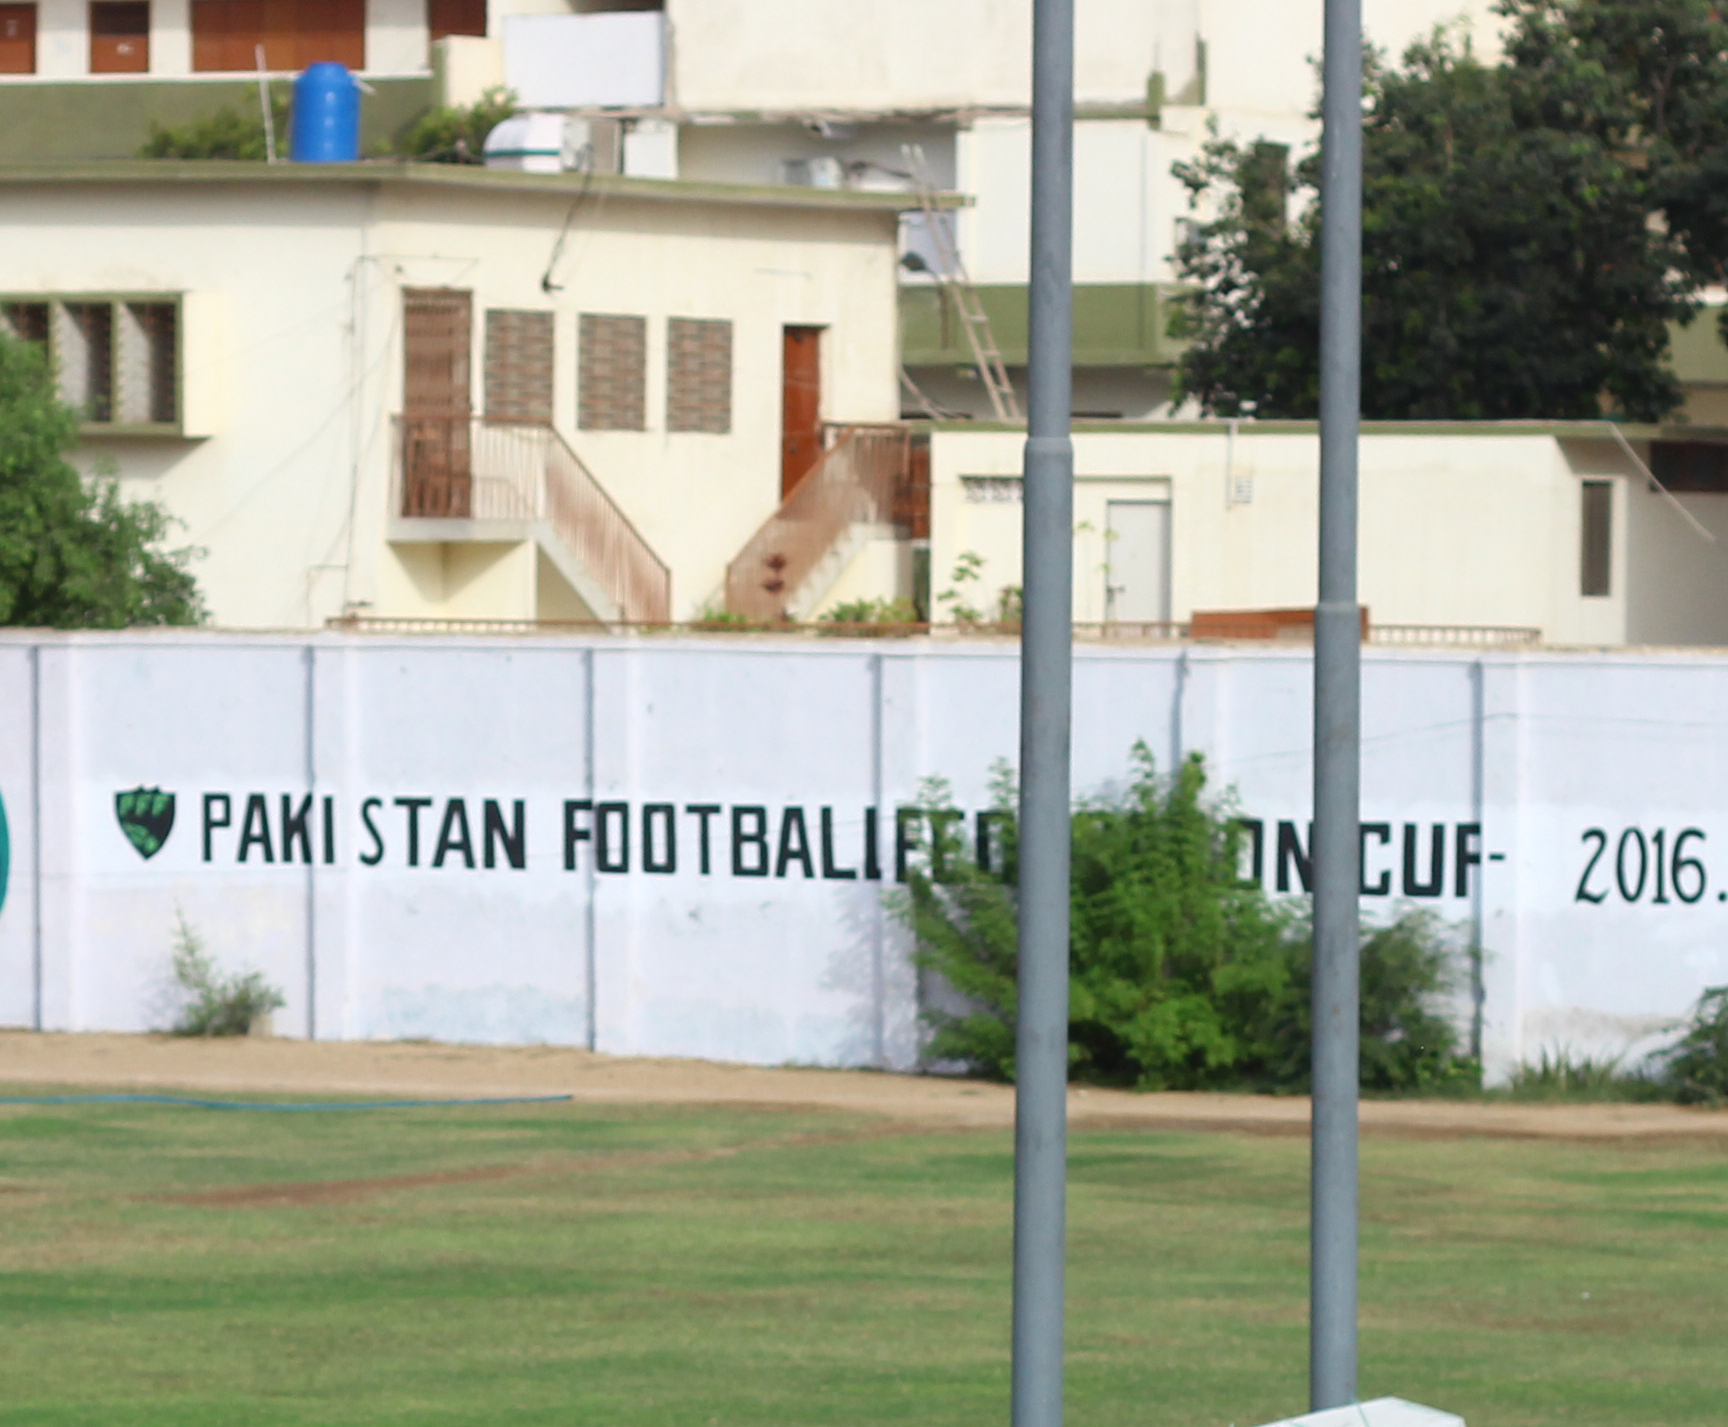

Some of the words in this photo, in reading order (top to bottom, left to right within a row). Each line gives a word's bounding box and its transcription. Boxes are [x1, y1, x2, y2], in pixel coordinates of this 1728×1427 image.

[201, 792, 527, 871] PAKISTAN
[562, 799, 882, 880] FOOTBALL
[1574, 826, 1728, 904] 2016.
